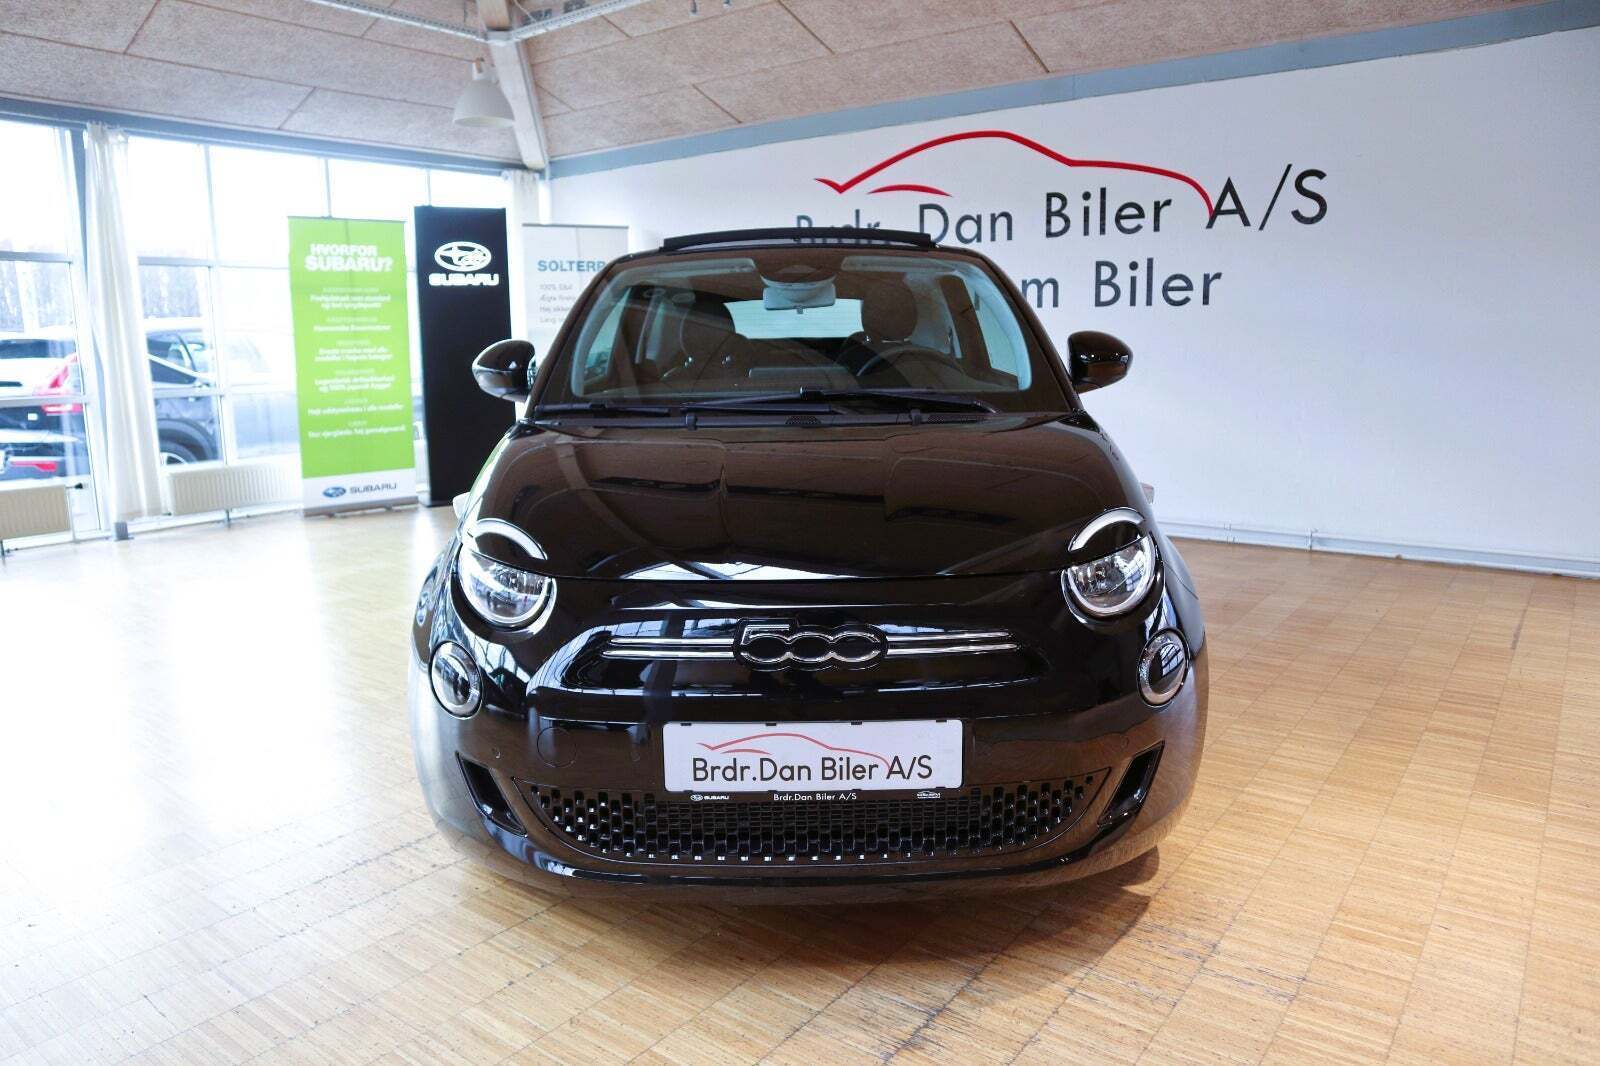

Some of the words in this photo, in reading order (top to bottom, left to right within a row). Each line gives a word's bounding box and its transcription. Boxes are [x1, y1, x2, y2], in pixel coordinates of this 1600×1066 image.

[918, 202, 1014, 245] Dan
[1044, 187, 1172, 240] Biler
[1205, 163, 1329, 232] A/S
[309, 243, 378, 256] HVORFOR
[304, 255, 394, 272] SUBARU?
[537, 259, 607, 273] SOLTERR
[428, 272, 500, 287] SUBARU
[1093, 257, 1223, 308] Biler
[349, 482, 398, 495] SUBARU
[739, 622, 883, 664] 500
[821, 755, 879, 782] Biler
[885, 753, 934, 781] A/S
[815, 792, 836, 801] Biler
[838, 792, 857, 801] A/S
